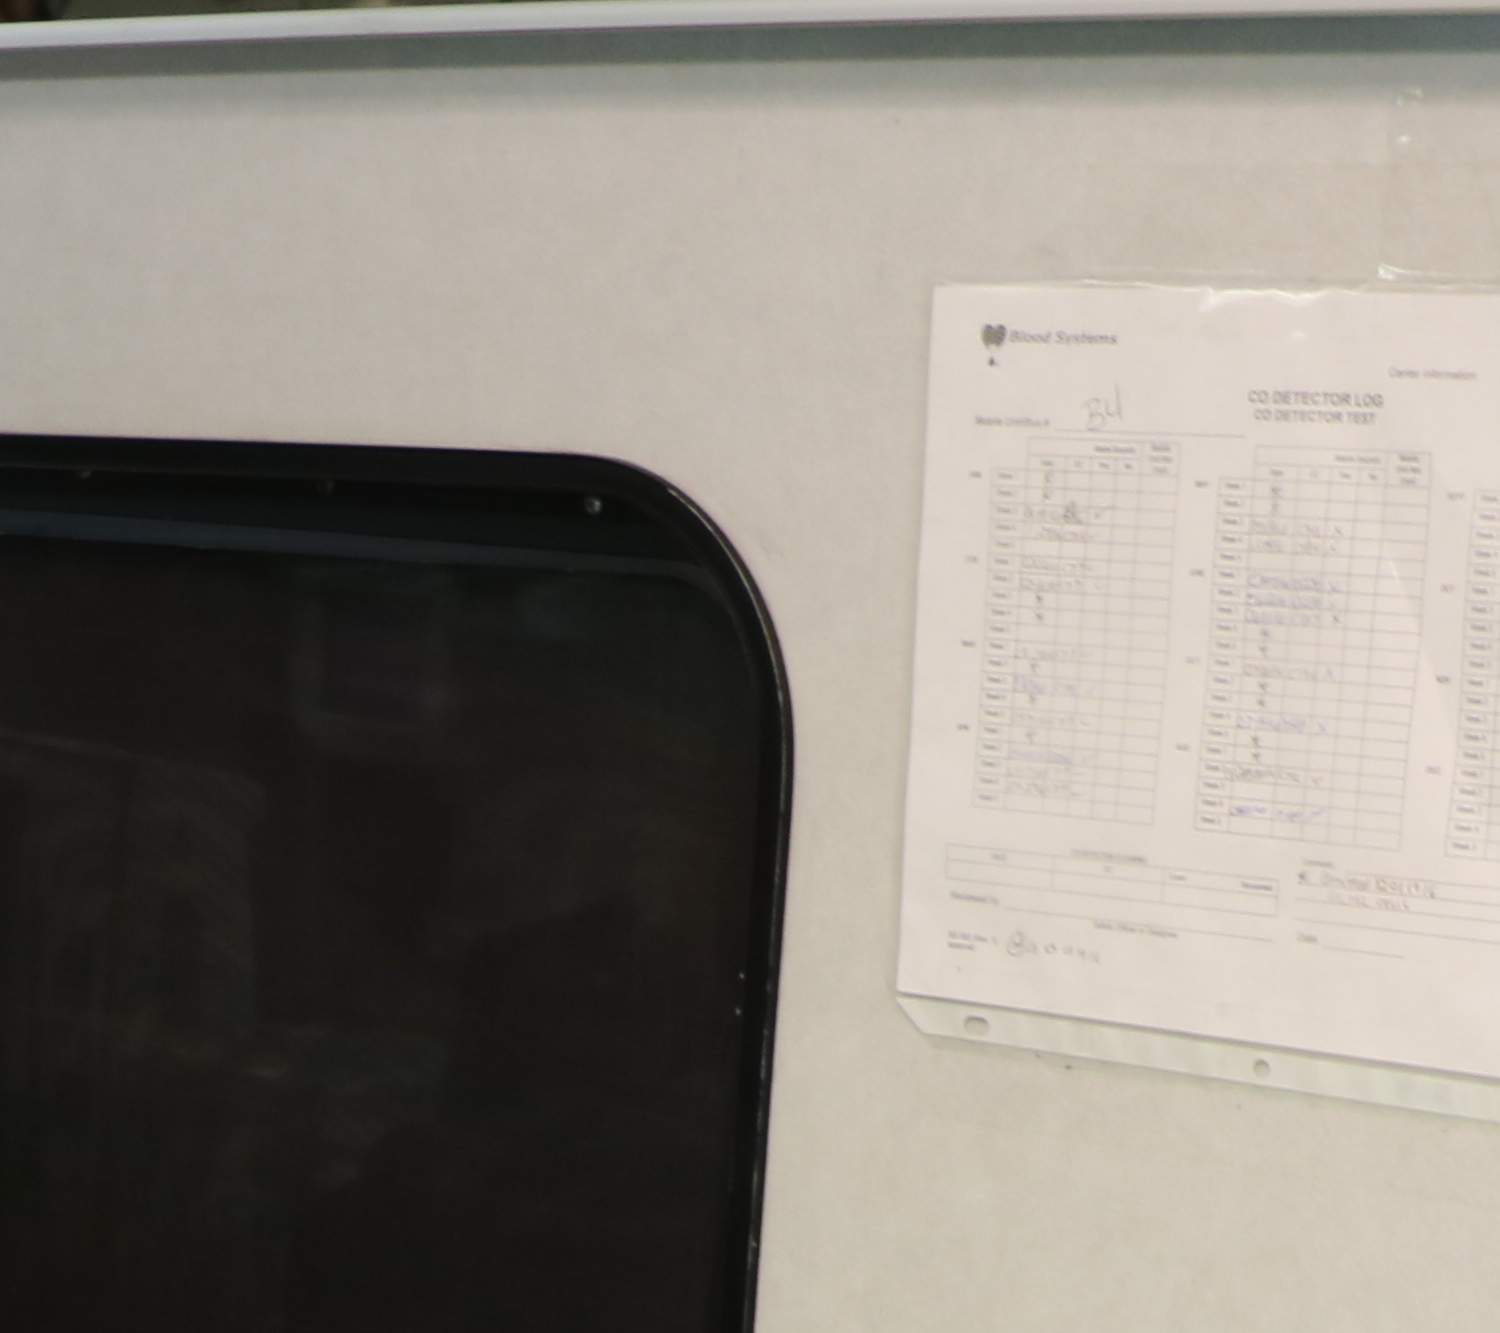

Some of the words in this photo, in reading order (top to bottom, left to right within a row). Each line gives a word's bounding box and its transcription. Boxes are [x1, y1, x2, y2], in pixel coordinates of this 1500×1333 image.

[1010, 330, 1051, 343] Blood
[1054, 331, 1118, 345] Systems
[1248, 390, 1272, 404] CO
[1275, 391, 1352, 407] DETECTOR
[1354, 393, 1384, 408] LOG
[1254, 408, 1273, 422] CO
[1275, 409, 1343, 424] DETECTOR
